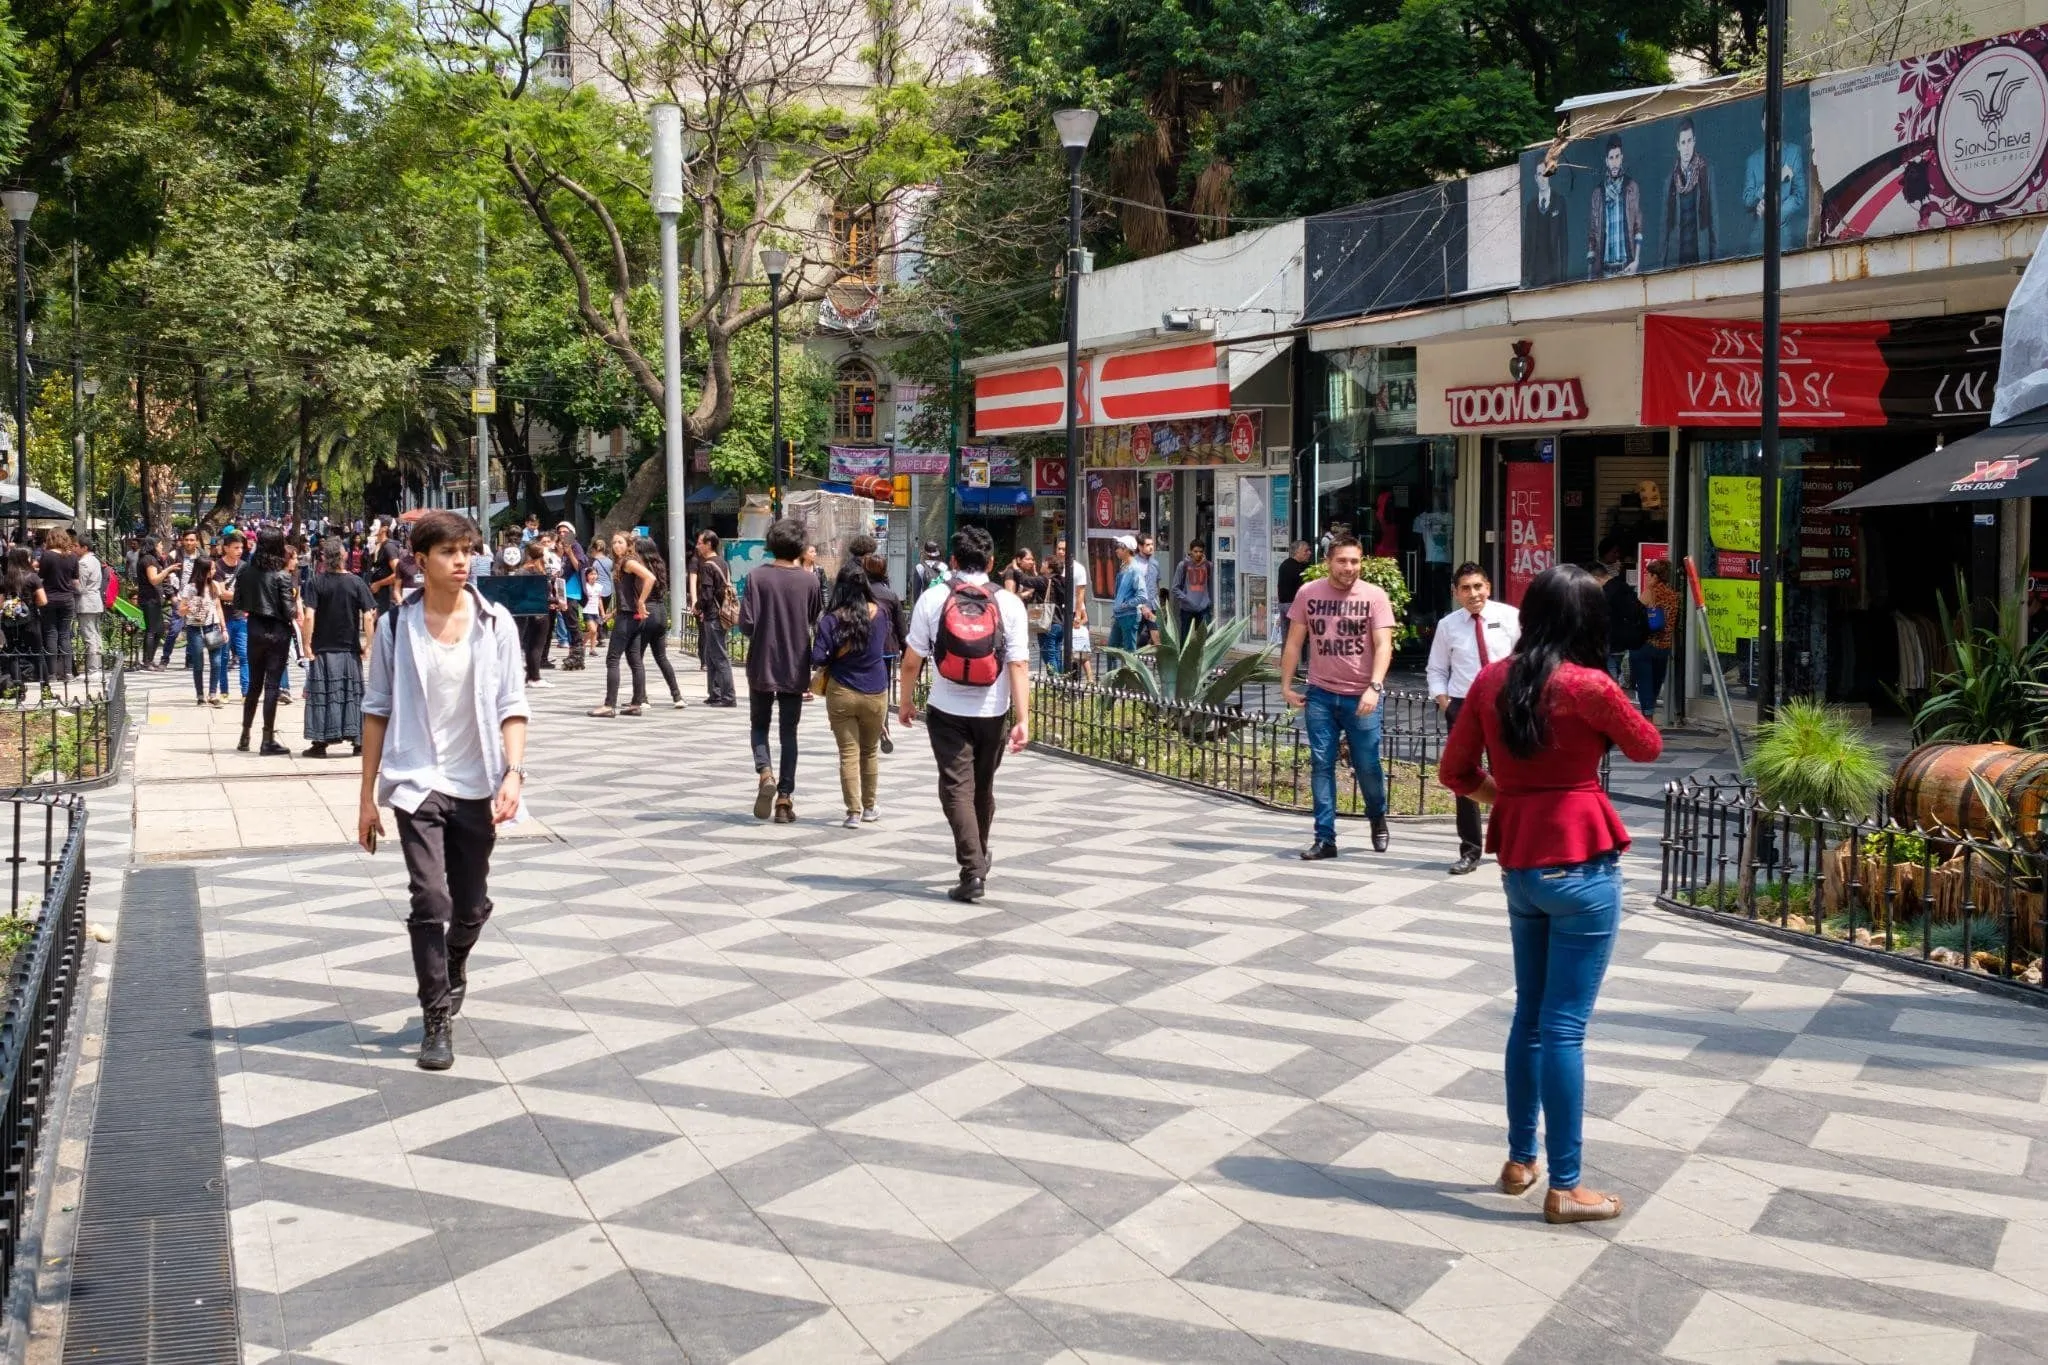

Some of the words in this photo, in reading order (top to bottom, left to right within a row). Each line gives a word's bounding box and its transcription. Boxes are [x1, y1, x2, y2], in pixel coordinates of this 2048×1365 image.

[896, 404, 913, 413] FAX
[1447, 381, 1579, 424] TODOMODA
[1949, 482, 1973, 492] DOS
[1511, 520, 1538, 546] BA
[1834, 568, 1851, 580] 899
[1308, 618, 1325, 636] NO
[1337, 618, 1367, 637] ONE
[1316, 638, 1364, 656] CARES
